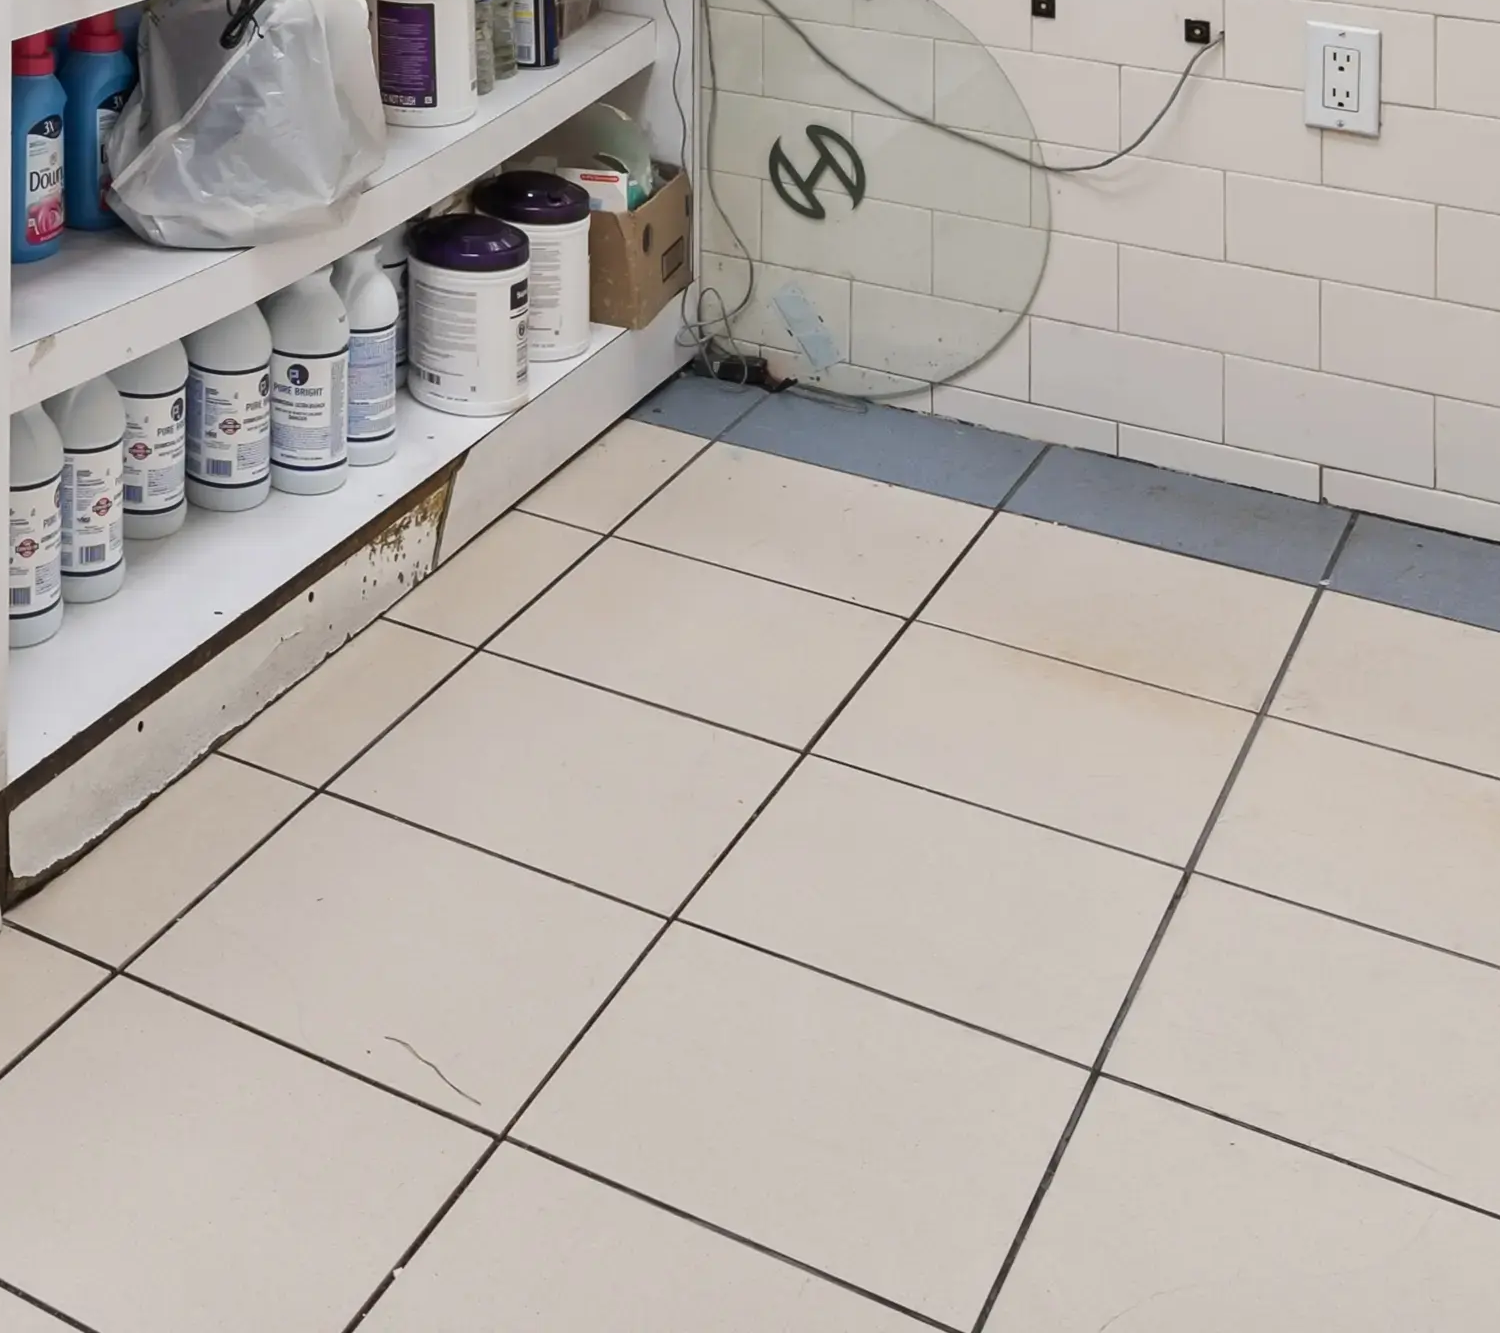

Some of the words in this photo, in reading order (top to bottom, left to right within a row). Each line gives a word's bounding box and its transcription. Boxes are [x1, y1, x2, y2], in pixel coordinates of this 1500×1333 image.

[29, 165, 64, 192] Down
[273, 382, 292, 396] PURE
[294, 386, 323, 397] BRIGHT
